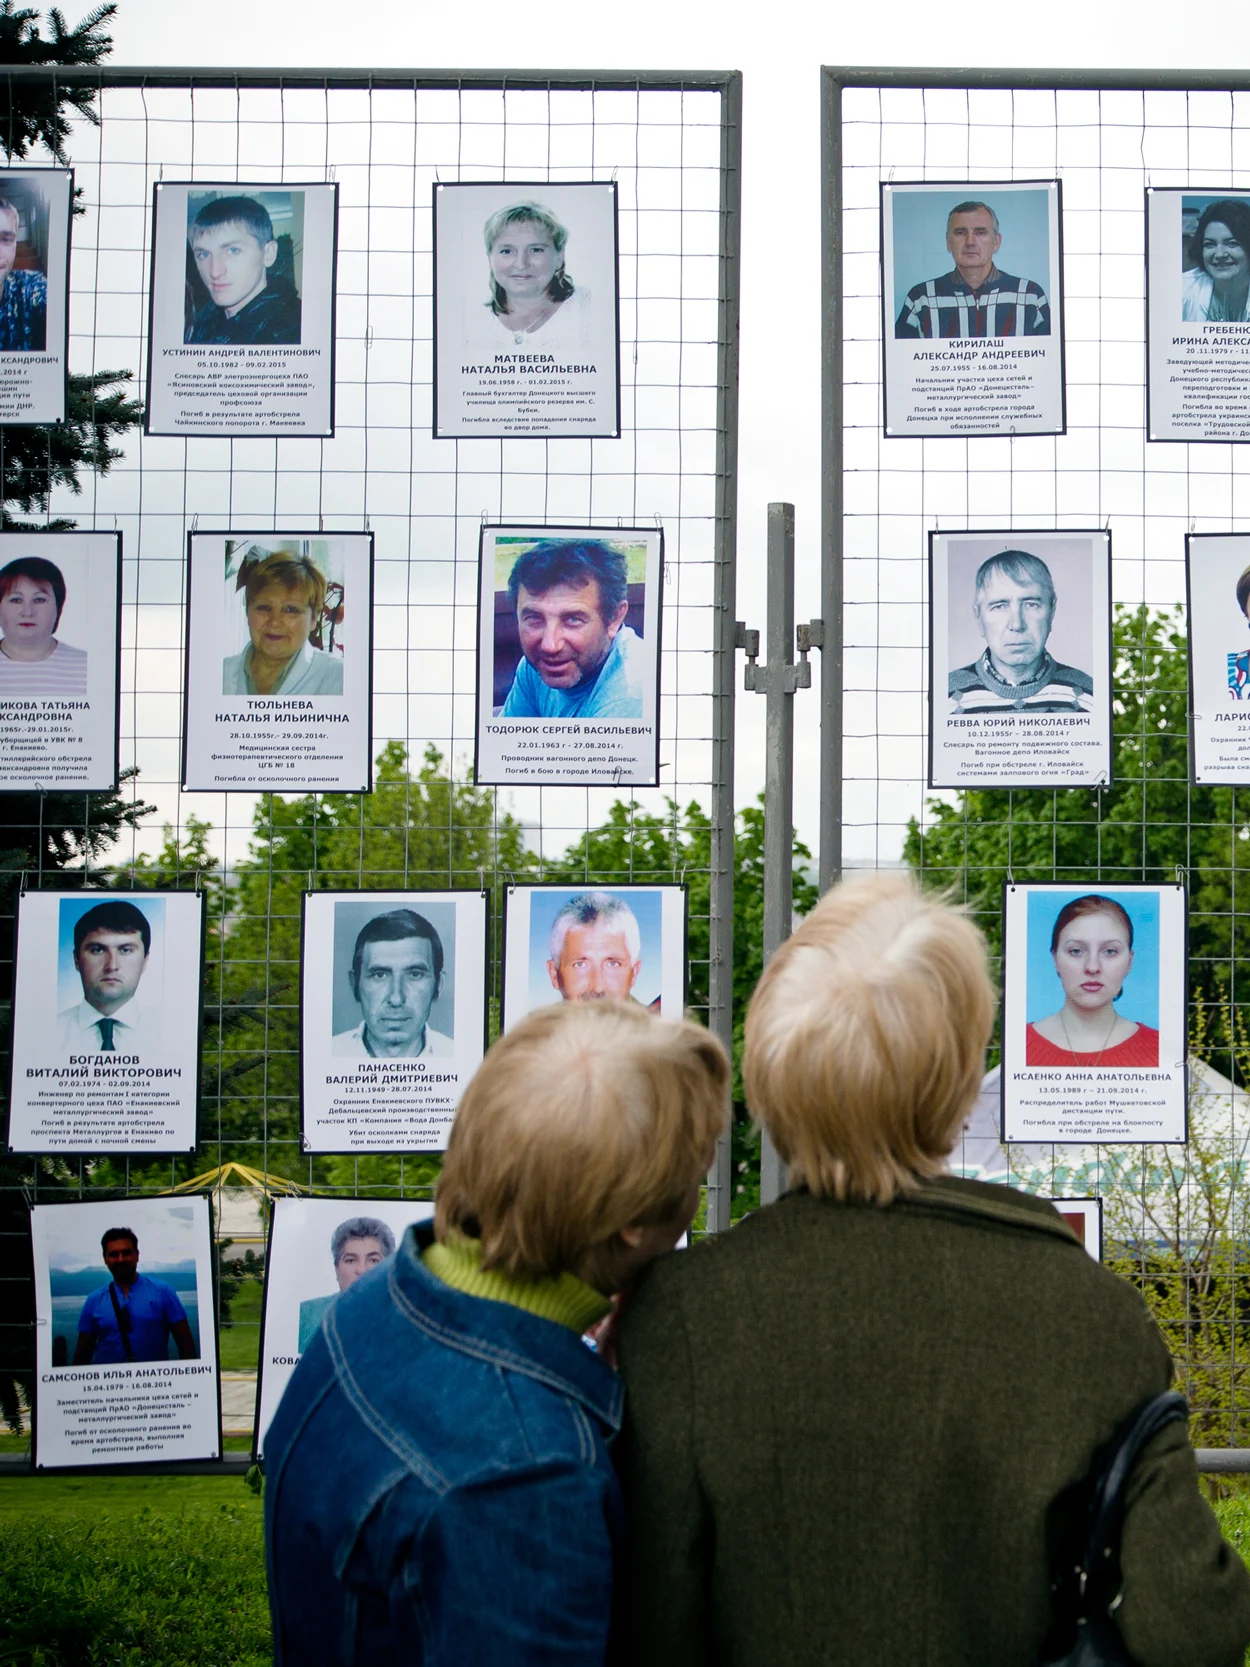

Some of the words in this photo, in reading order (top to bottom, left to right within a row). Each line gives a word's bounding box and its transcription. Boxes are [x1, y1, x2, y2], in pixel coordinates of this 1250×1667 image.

[949, 340, 1004, 348] КИРИЛАШ
[1172, 337, 1209, 345] ИРИНА
[208, 348, 245, 358] АНДРЕЙ
[913, 352, 978, 361] АЛЕКСАНДР
[981, 349, 1045, 360] АНДРЕЕВИЧ
[494, 355, 555, 363] МАТВЕЕВА
[462, 365, 515, 374] НАТАЛЬЯ
[520, 365, 597, 373] ВАСИЛЬЕВНА
[41, 702, 90, 710] ТАТЬЯНА
[247, 701, 313, 709] ТЮЛЬНЕВА
[215, 714, 270, 722] НАТАЛЬЯ
[275, 714, 350, 722] ИЛЬИНИЧНА
[983, 717, 1015, 727] ЮРИЙ
[1019, 718, 1090, 726] НИКОЛАЕВИЧ
[486, 726, 539, 735] ТОДОРЮК
[542, 724, 580, 734] СЕРГЕЙ
[584, 726, 652, 734] ВАСИЛЬЕВИЧ
[69, 1055, 140, 1066] БОГДАНОВ
[26, 1066, 89, 1077] ВИТАЛИЙ
[94, 1068, 181, 1077] ВИКТОРОВИЧ
[358, 1063, 426, 1072] ПАНАСЕНКО
[326, 1073, 377, 1084] ВАЛЕРИЙ
[381, 1074, 458, 1085] ДМИТРИЕВИЧ
[1096, 1073, 1171, 1081] АНАТОЛЬЕВНА
[42, 1372, 100, 1383] САМСОНОВ
[103, 1370, 132, 1379] ИЛЬЯ
[135, 1366, 212, 1378] АНАТОЛЬЕВИЧ
